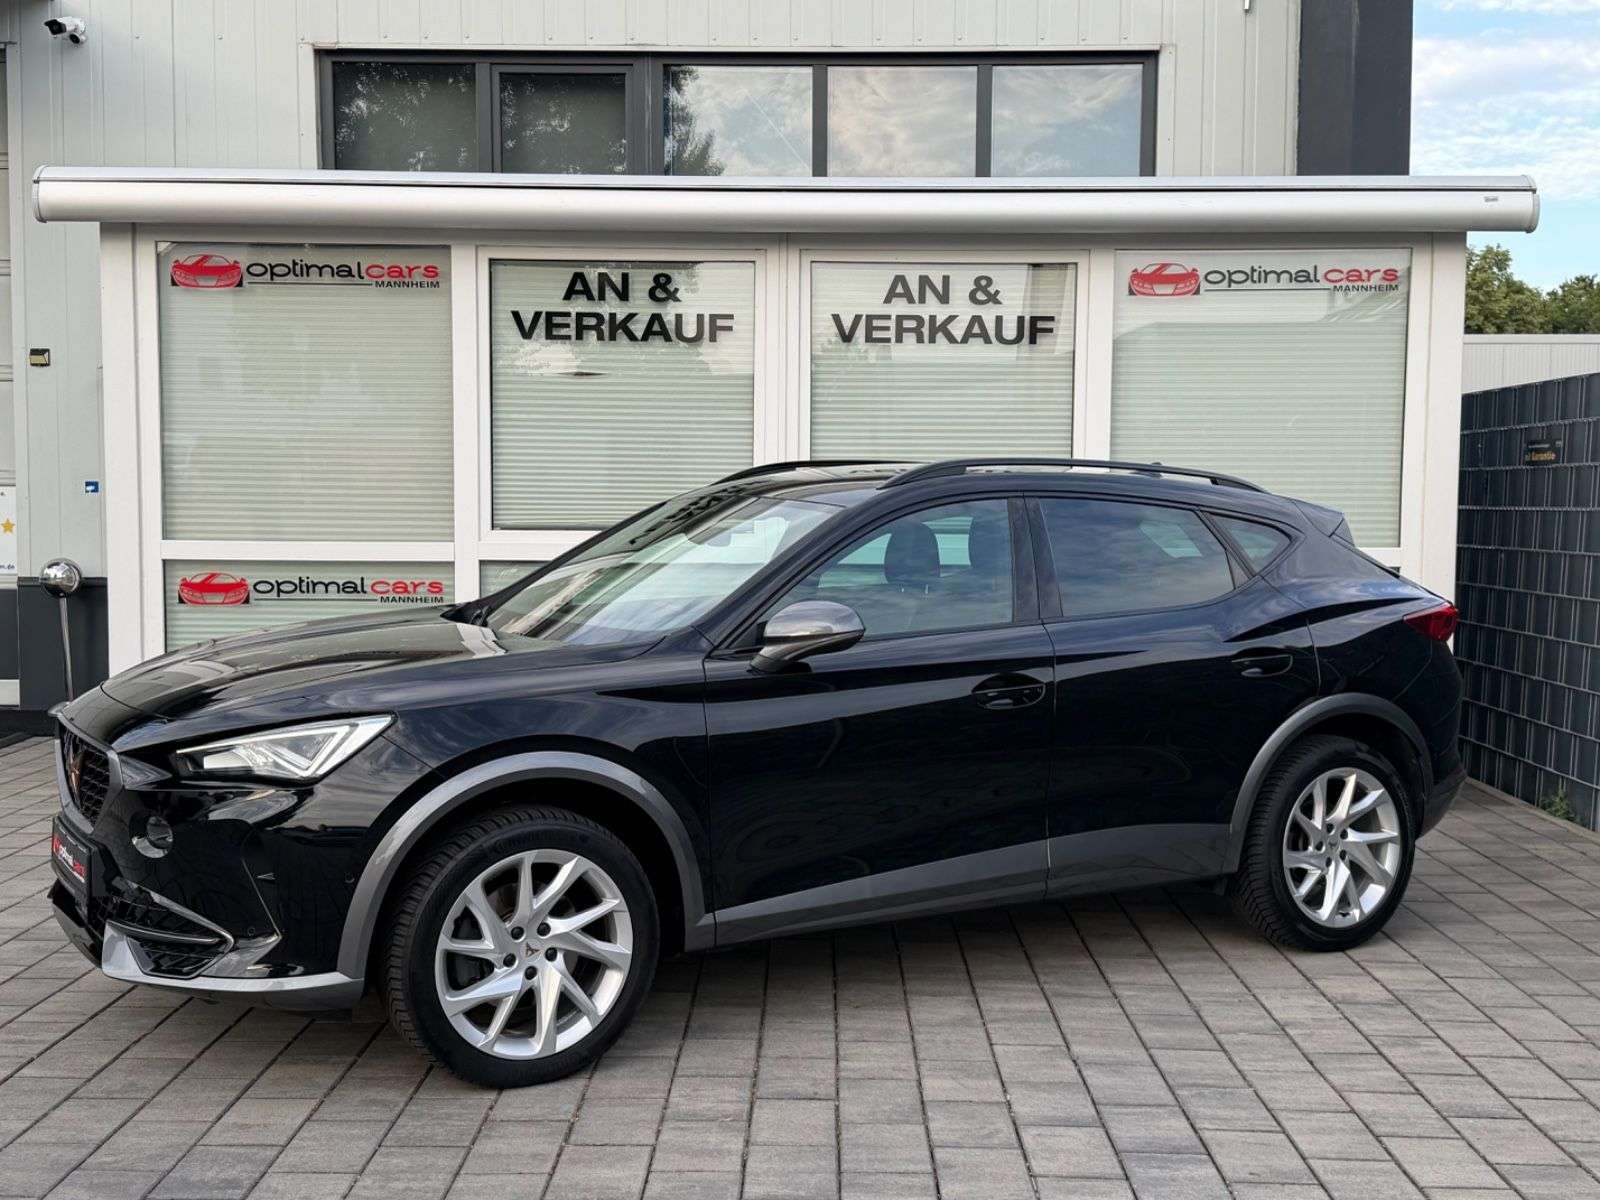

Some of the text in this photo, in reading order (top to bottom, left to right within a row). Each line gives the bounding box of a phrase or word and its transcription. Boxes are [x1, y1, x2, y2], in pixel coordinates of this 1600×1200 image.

[375, 280, 440, 289] MANNHEIM
[562, 271, 682, 303] AN &
[882, 274, 1003, 306] AN &
[1333, 284, 1400, 292] MANNHEIM
[510, 310, 735, 343] VERKAUF
[831, 313, 1055, 345] VERKAUF
[380, 595, 444, 603] MANNHEIM
